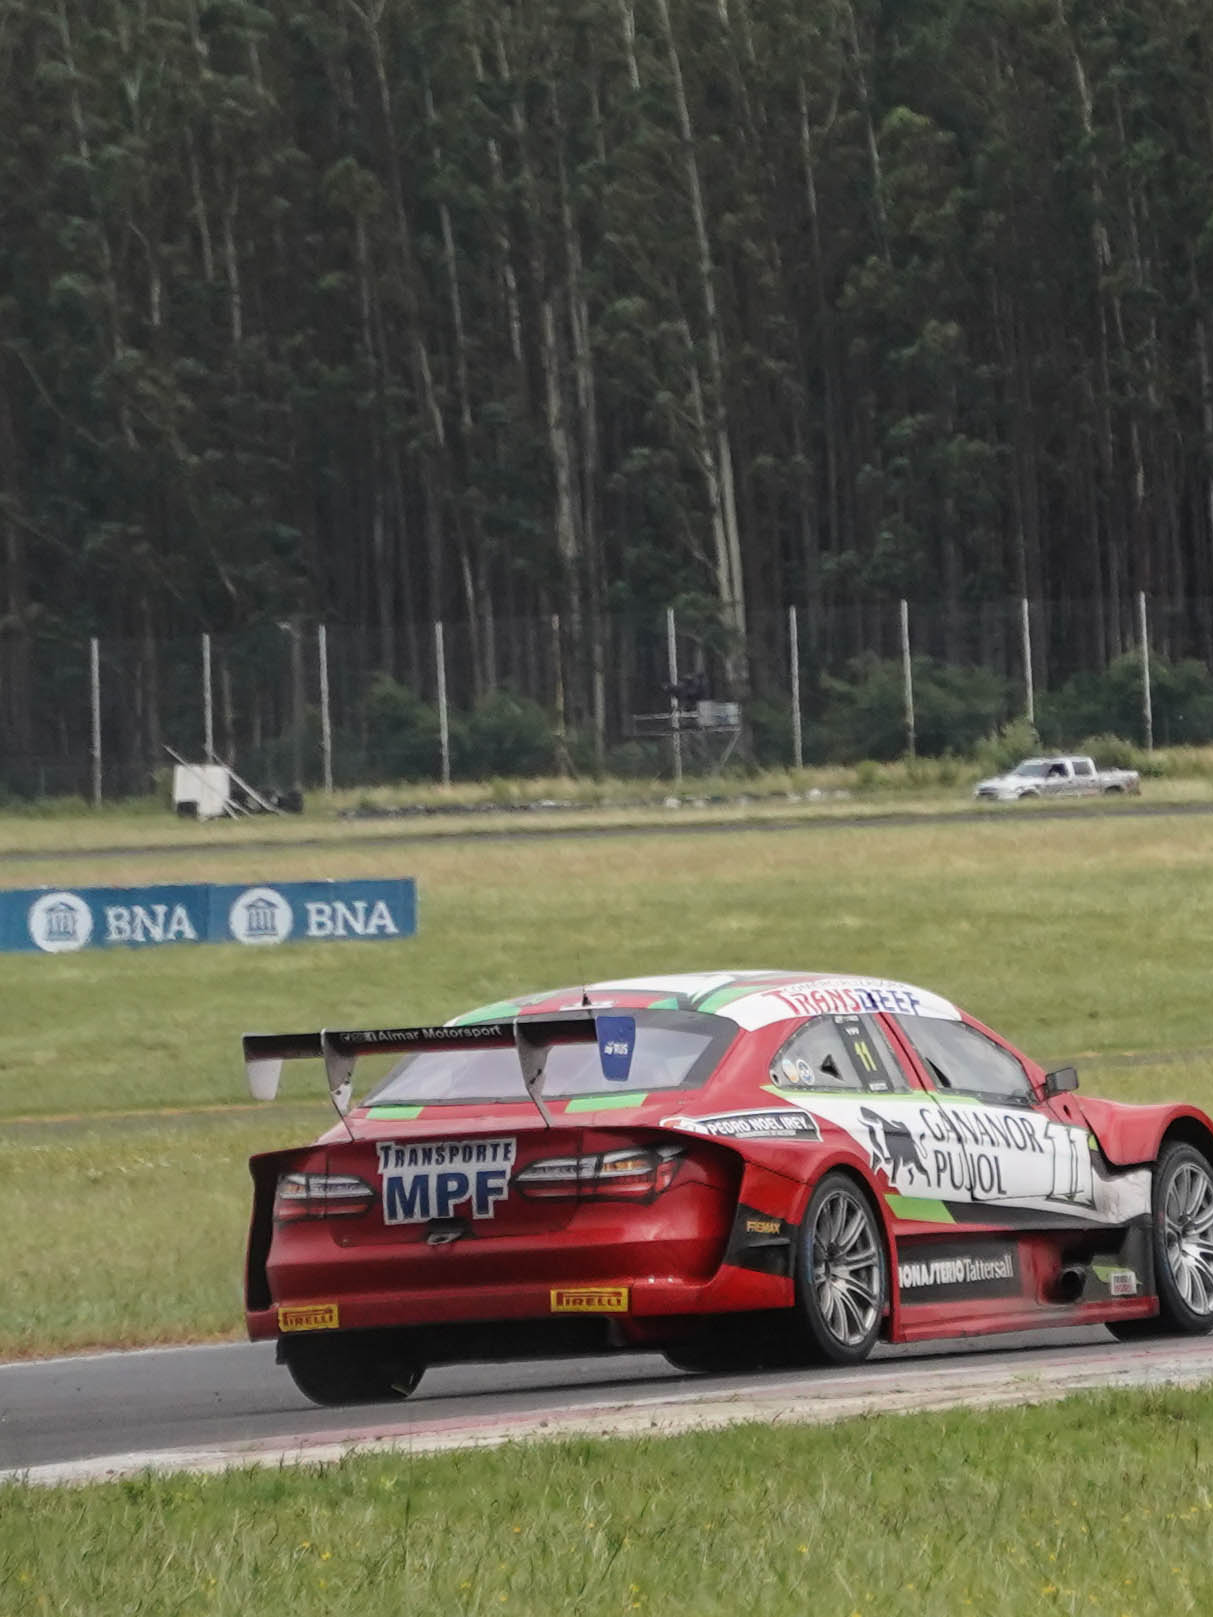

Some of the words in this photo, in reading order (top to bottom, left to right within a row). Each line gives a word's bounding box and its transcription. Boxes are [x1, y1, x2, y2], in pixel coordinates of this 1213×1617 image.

[105, 904, 197, 942] BNA
[304, 899, 399, 937] BNA
[422, 1025, 502, 1040] Motorsport
[855, 1041, 878, 1072] 11
[919, 1108, 1044, 1153] GANANOR
[380, 1143, 513, 1169] TRANSPORTE
[933, 1150, 1007, 1195] PUJOL
[386, 1170, 507, 1220] MPF
[964, 1254, 1014, 1282] Tattersall
[556, 1291, 622, 1307] PIRELLI
[282, 1309, 333, 1326] PIRELLI
